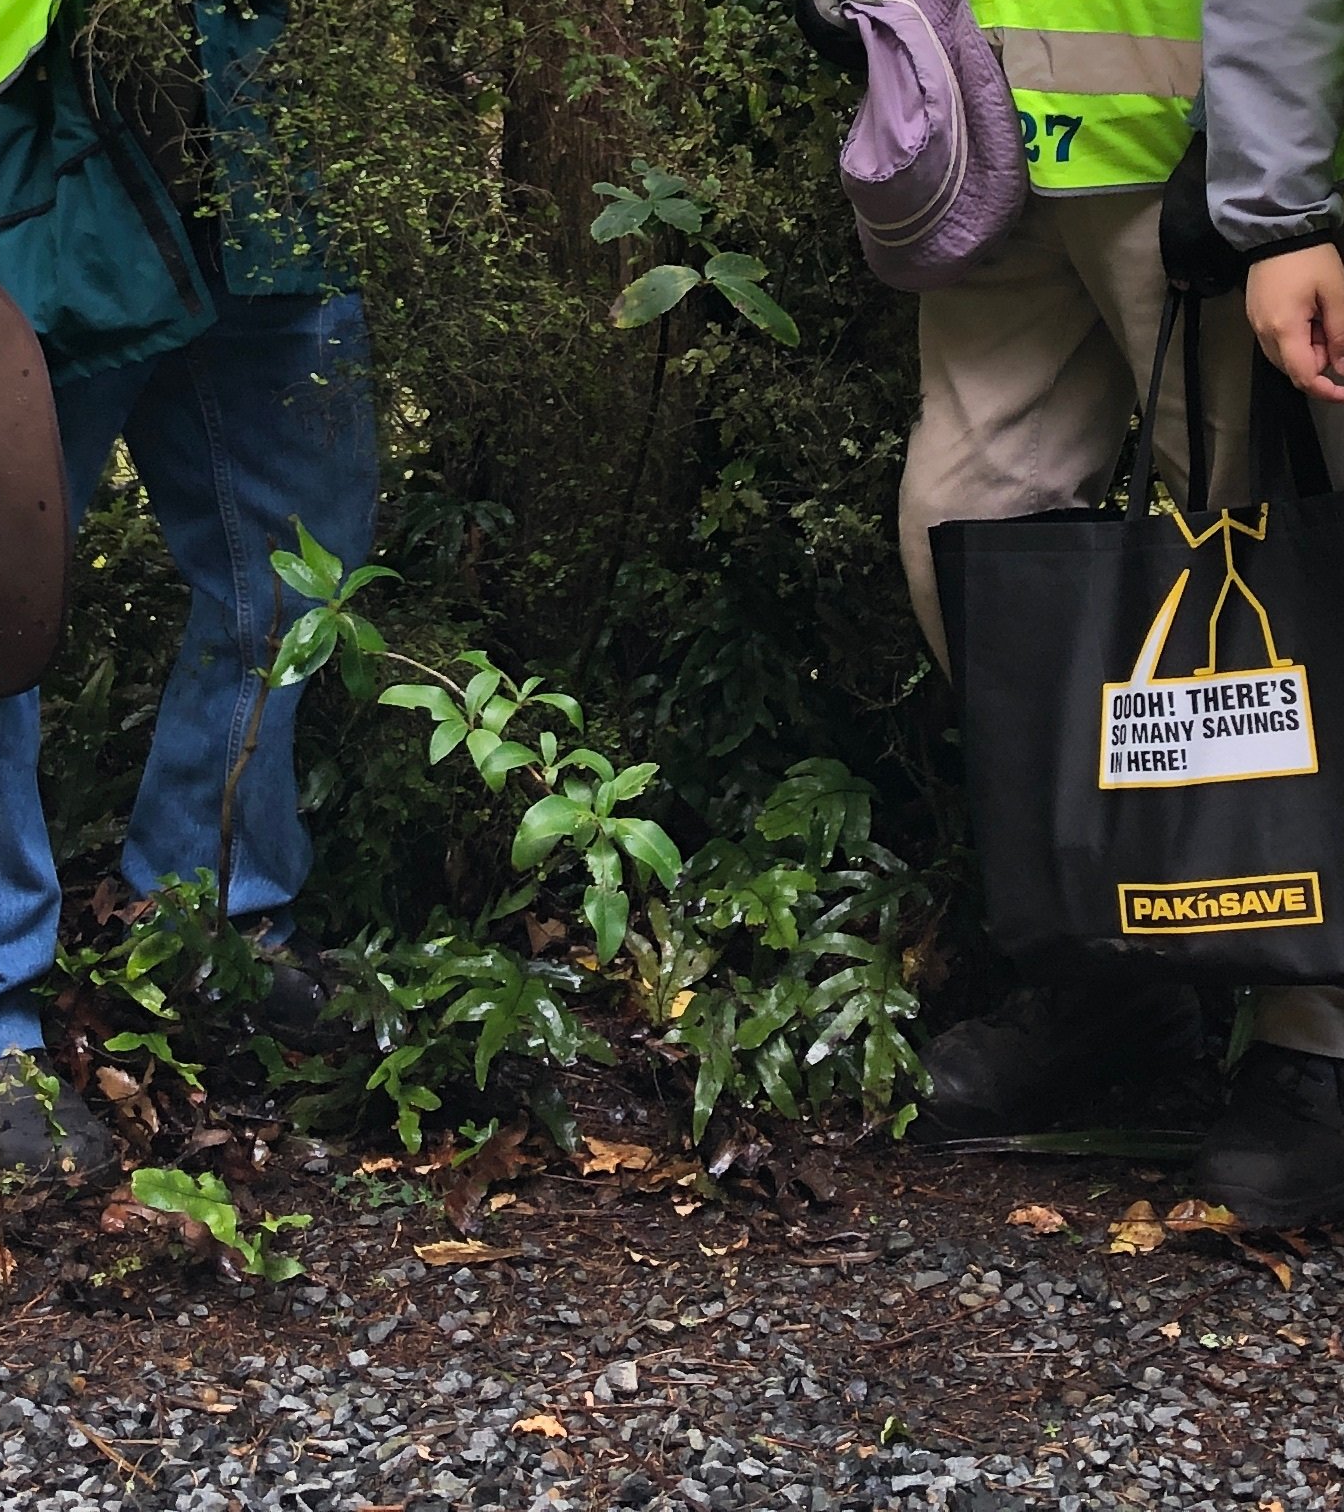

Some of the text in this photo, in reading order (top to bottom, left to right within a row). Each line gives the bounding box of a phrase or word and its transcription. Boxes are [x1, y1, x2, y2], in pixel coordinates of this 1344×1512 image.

[1113, 679, 1298, 720] OOOH! THERE'S
[1111, 709, 1299, 746] SO MANY SAVINGS
[1110, 749, 1188, 774] IN HERE!
[1133, 887, 1306, 920] PAK'nSAVE
